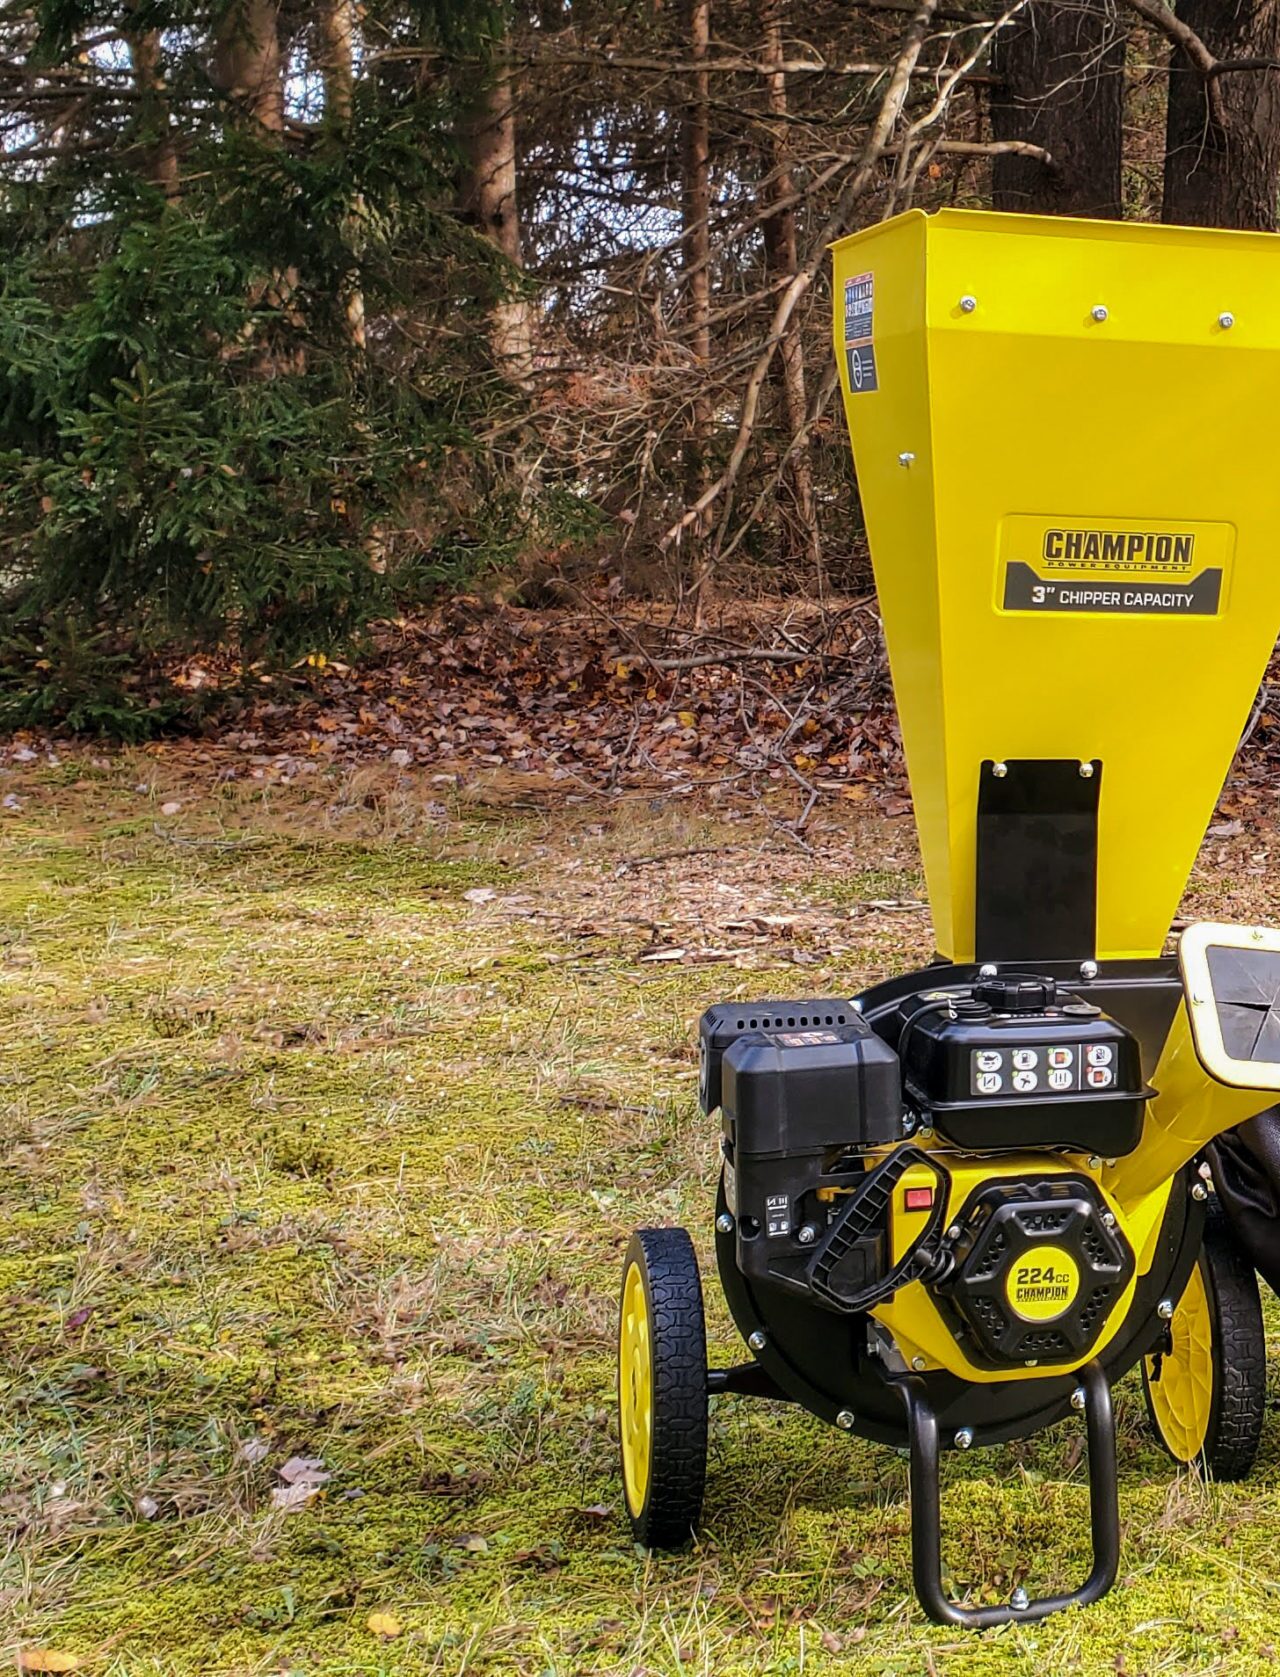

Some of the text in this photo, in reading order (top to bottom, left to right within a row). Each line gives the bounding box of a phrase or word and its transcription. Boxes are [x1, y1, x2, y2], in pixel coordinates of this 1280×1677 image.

[1045, 532, 1192, 563] CHAMPION
[1104, 563, 1187, 571] EQUIPMENT
[1032, 585, 1194, 607] 3" CHIPPER CAPACITY
[1016, 1286, 1068, 1298] CHAMPION
